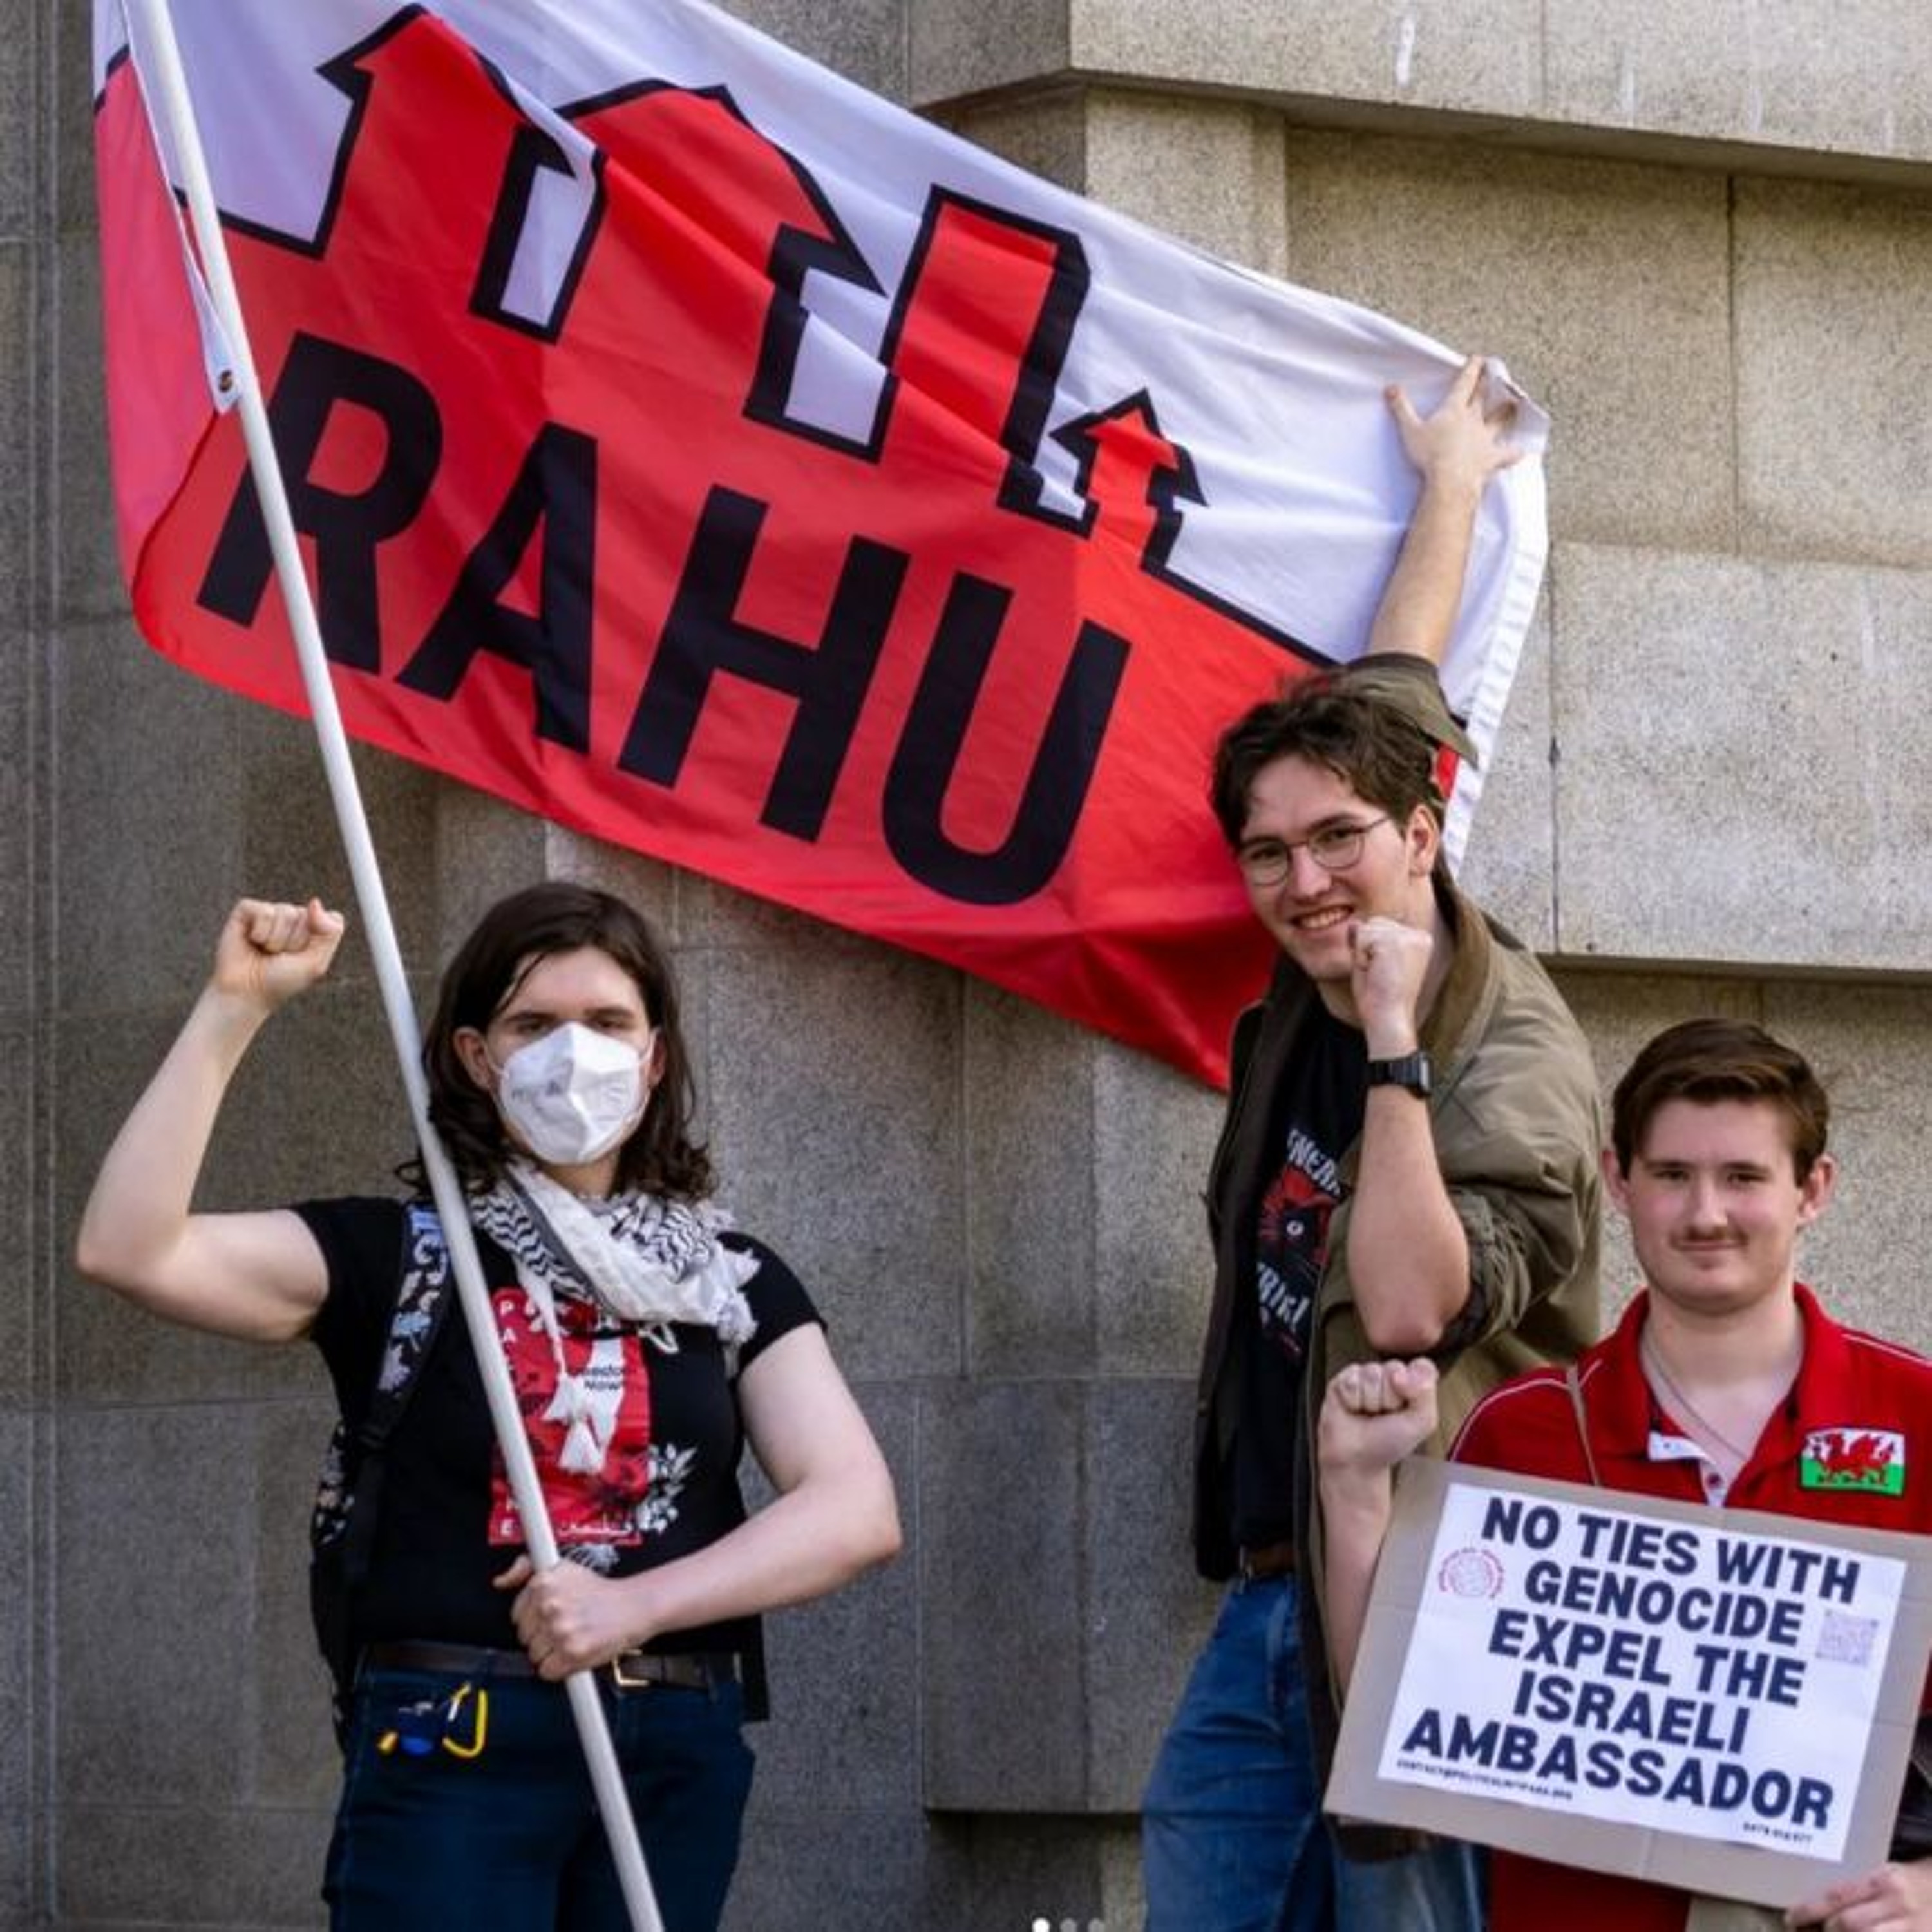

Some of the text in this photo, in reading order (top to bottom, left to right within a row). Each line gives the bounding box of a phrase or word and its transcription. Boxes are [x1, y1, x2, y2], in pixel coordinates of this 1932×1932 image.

[196, 331, 1132, 905] RAHU
[1482, 1498, 1859, 1603] NO TIES WITH
[1526, 1561, 1803, 1646] GENOCIDE
[1490, 1609, 1805, 1705] EXPEL THE
[1514, 1671, 1749, 1753] ISRAELI
[1403, 1710, 1832, 1828] AMBASSADOR
